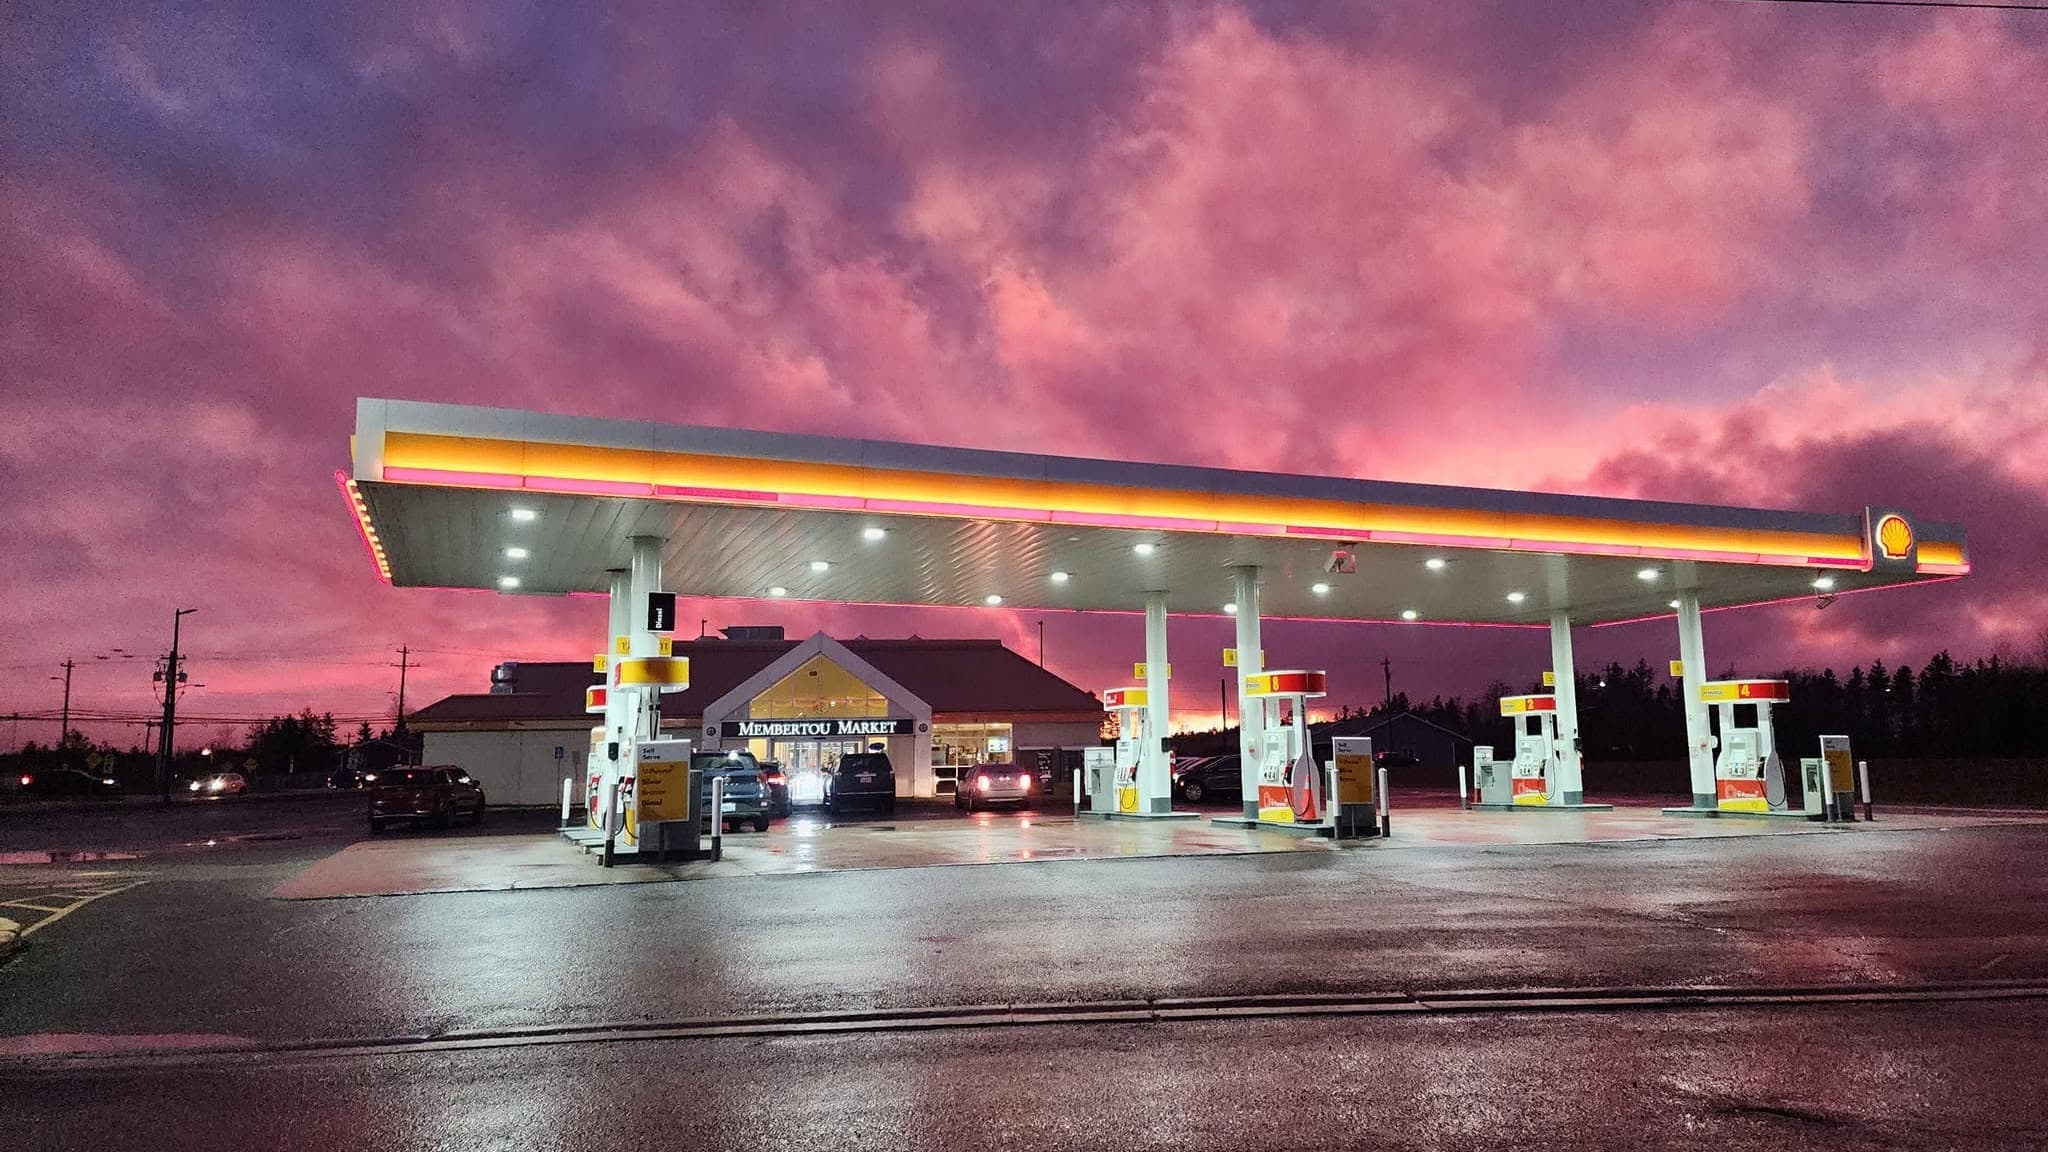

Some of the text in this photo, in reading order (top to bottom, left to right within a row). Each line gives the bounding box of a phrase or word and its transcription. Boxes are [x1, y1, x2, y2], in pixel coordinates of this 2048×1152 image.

[655, 608, 663, 629] Diesel
[1272, 676, 1280, 691] 8
[1741, 684, 1751, 697] 4
[1527, 698, 1535, 710] 2
[738, 721, 897, 736] MEMBERTOU MARKET
[641, 799, 663, 807] Diesel
